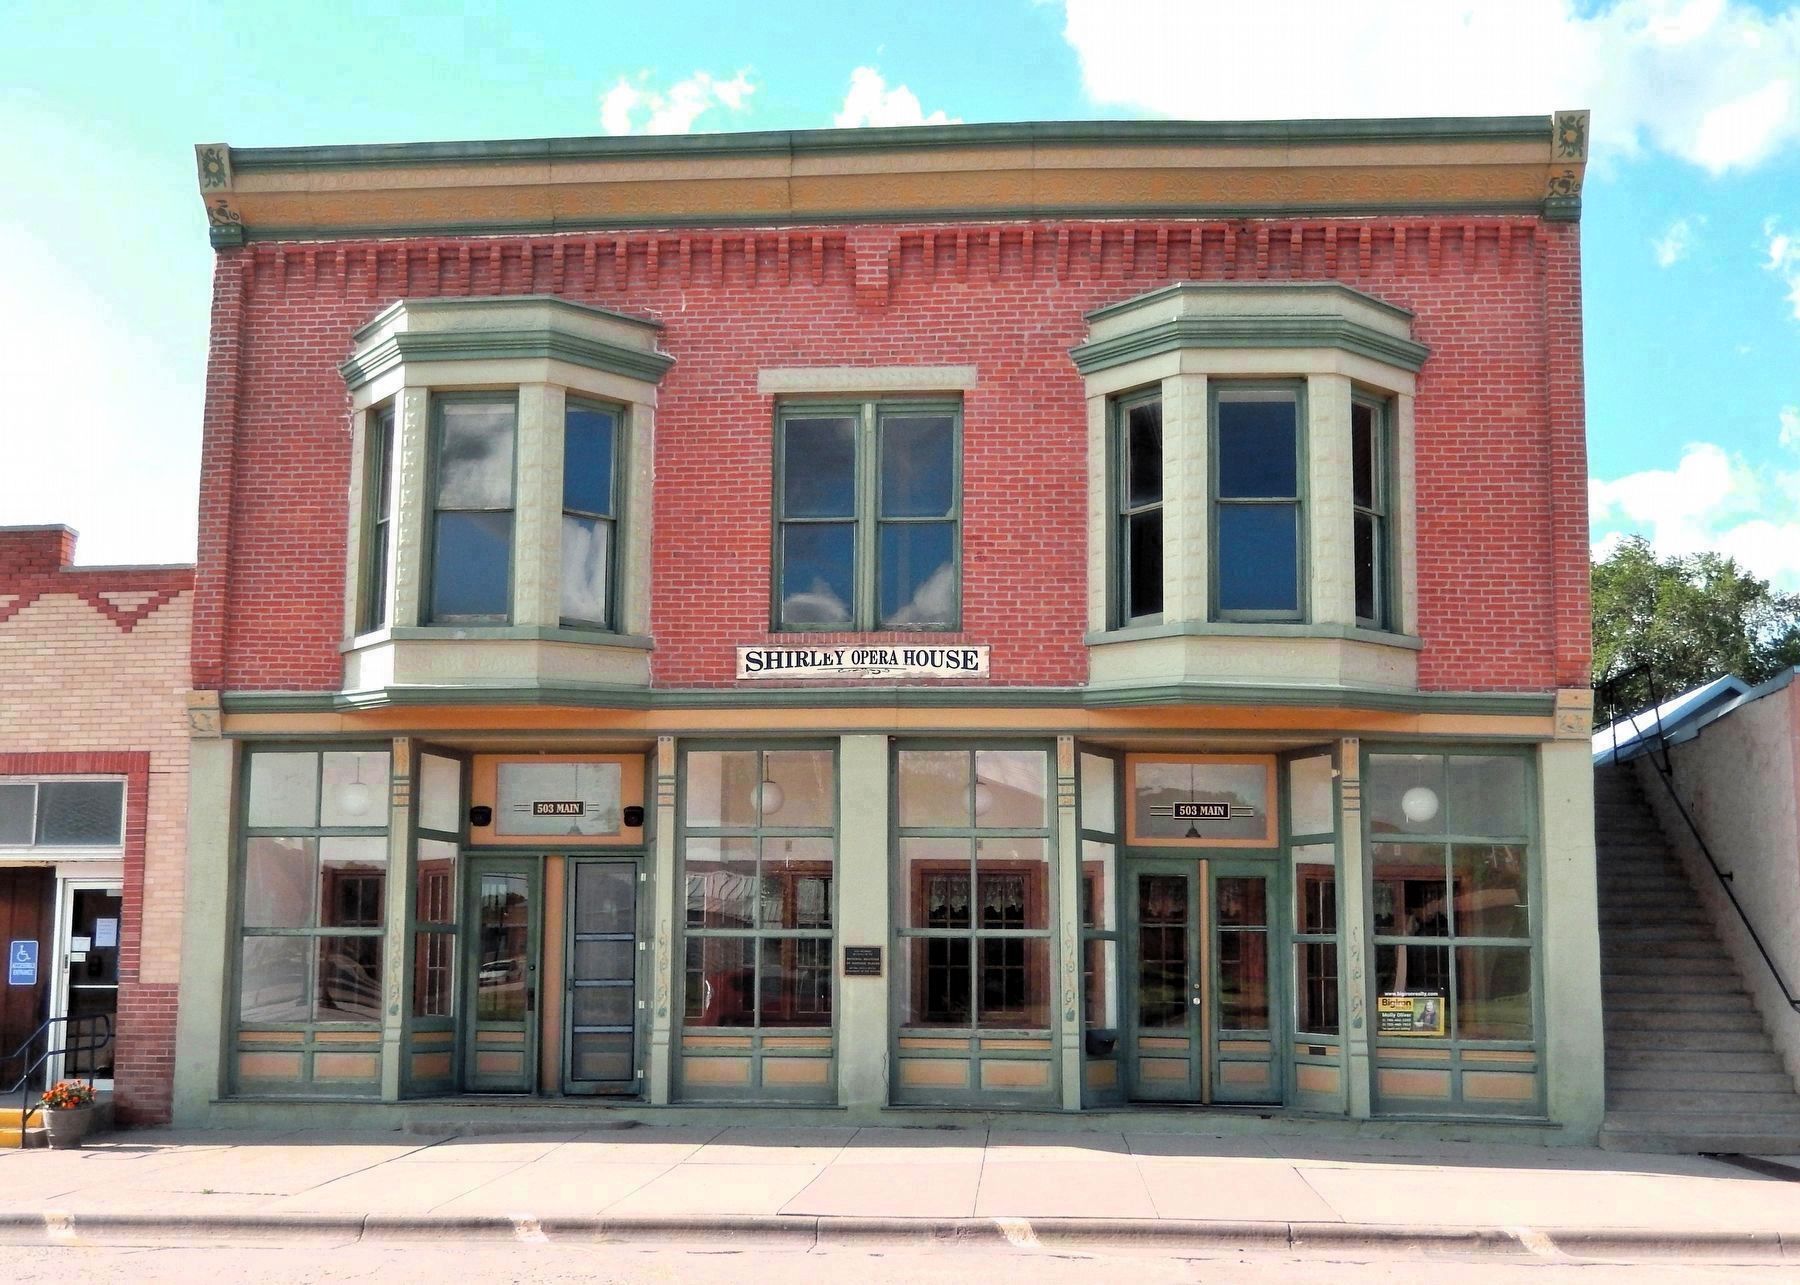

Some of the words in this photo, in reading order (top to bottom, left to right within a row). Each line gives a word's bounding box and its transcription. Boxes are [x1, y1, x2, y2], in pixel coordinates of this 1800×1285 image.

[745, 650, 845, 672] SHIRLEY
[851, 650, 899, 665] OPERA
[903, 650, 979, 670] HOUSE
[537, 803, 554, 813] 503
[556, 803, 580, 813] MAIN
[1179, 805, 1197, 815] 503
[1200, 806, 1224, 815] MAIN
